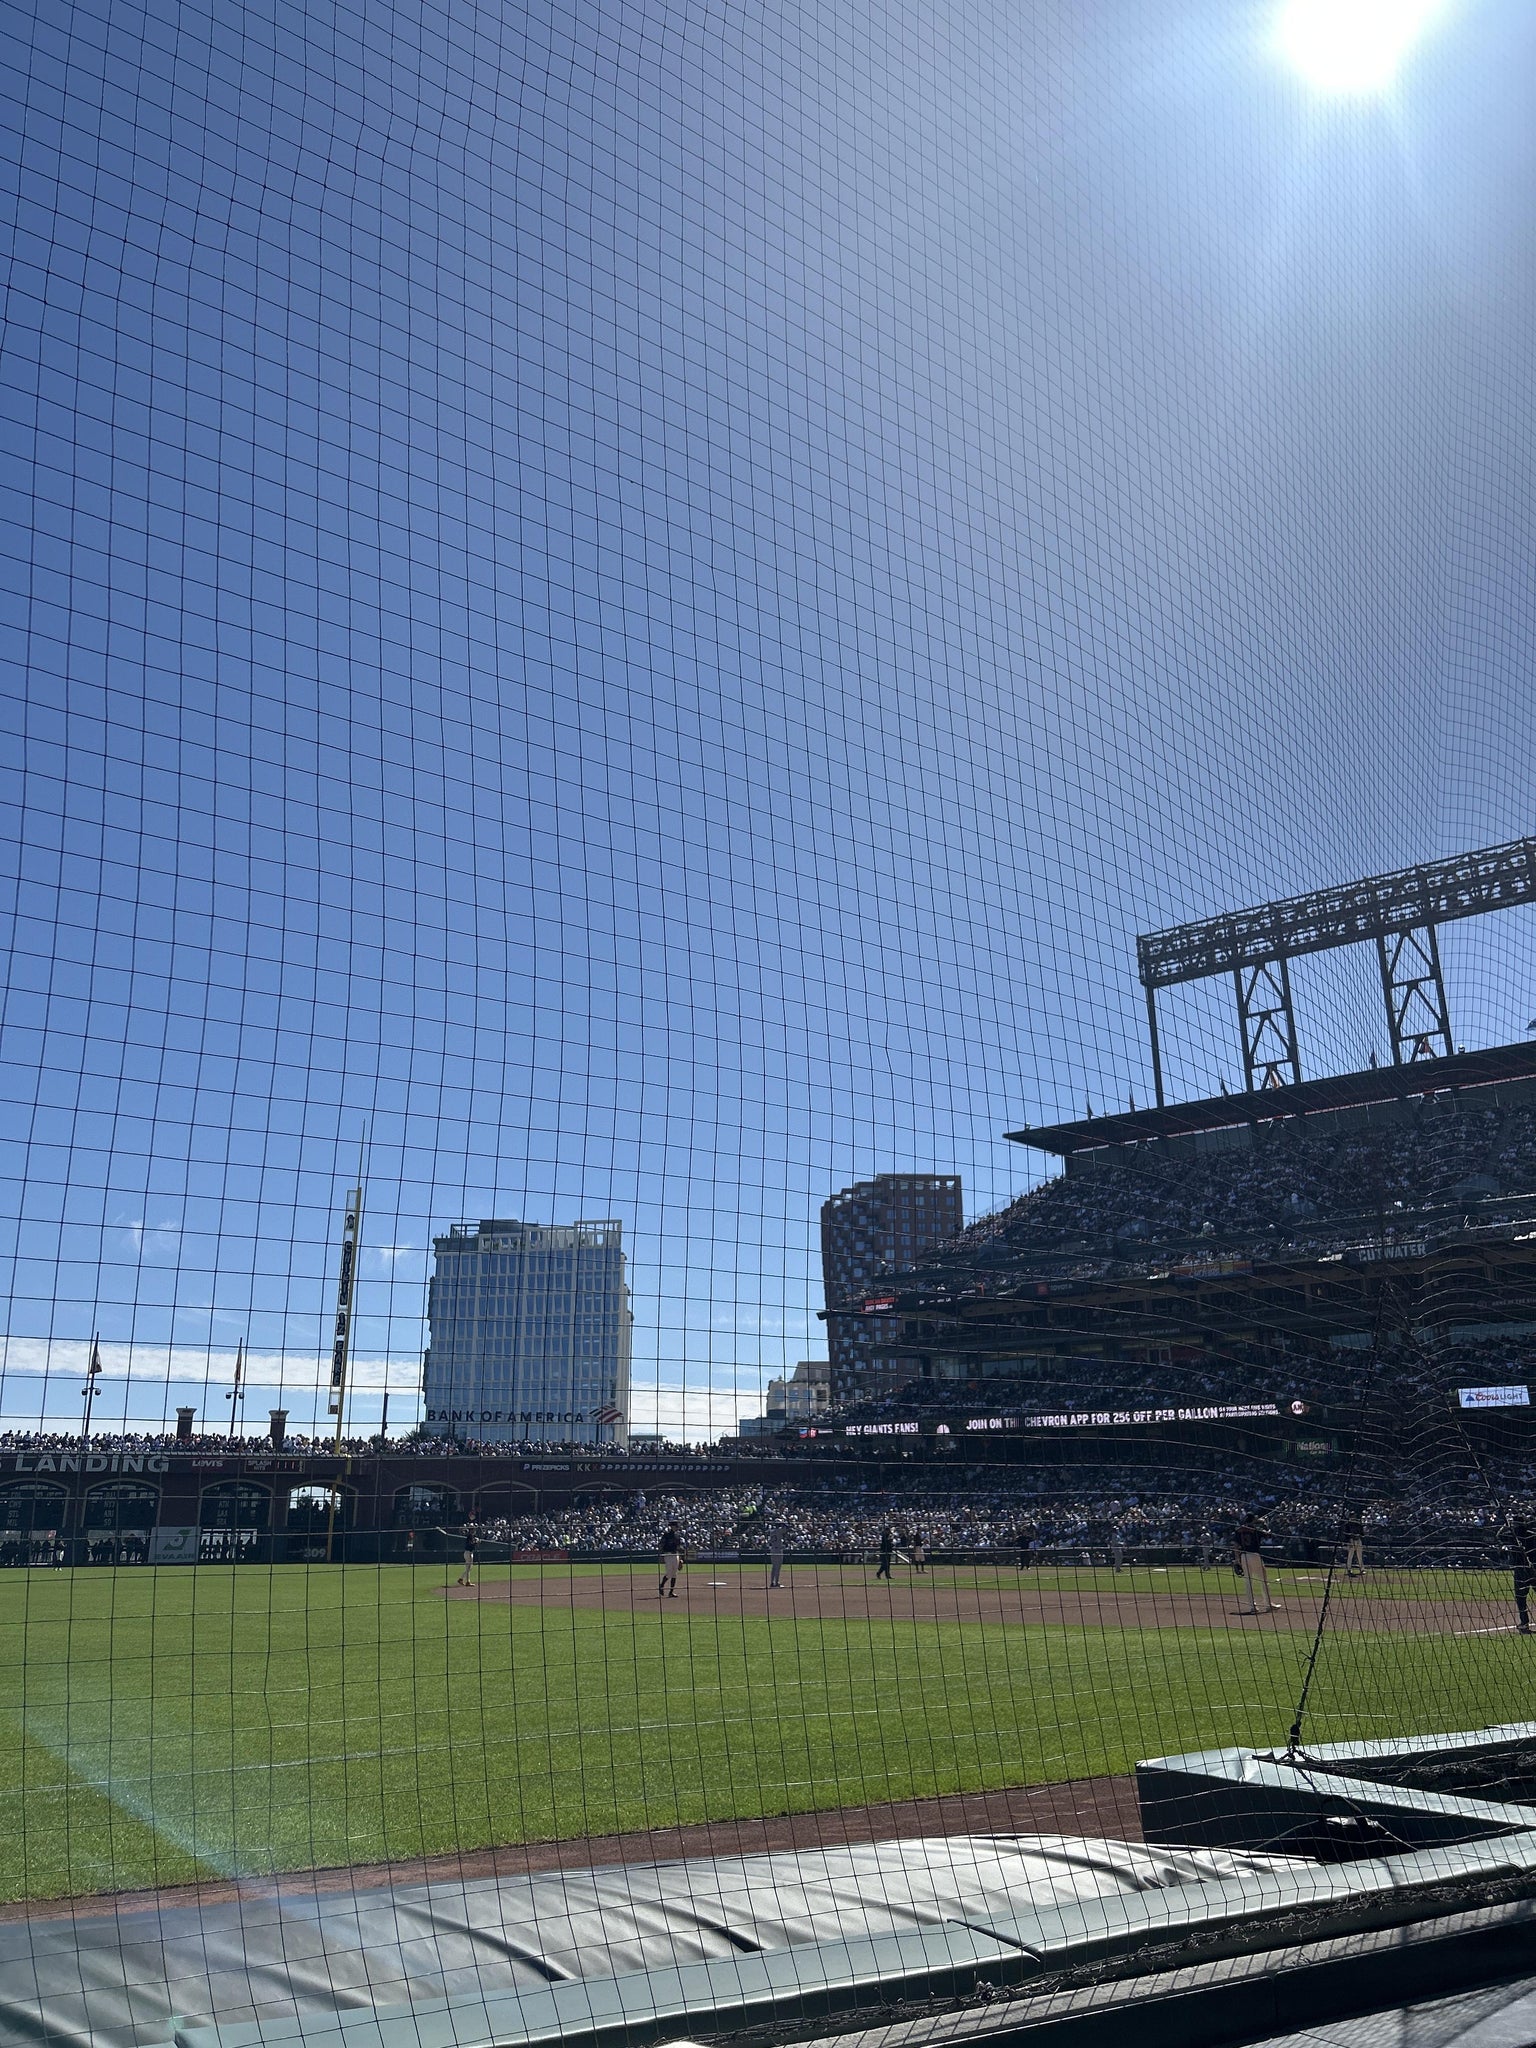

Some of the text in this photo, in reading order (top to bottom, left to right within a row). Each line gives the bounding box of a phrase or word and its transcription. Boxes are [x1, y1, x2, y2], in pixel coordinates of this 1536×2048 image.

[1358, 1243, 1426, 1262] CUTWATER
[1475, 1392, 1523, 1402] Coors LIGHT
[427, 1409, 584, 1423] BANK OF AMERICA
[966, 1418, 988, 1430] JOIN
[989, 1418, 1002, 1429] ON
[1024, 1415, 1067, 1427] CHEVRON
[1070, 1413, 1089, 1425] APP
[1091, 1412, 1110, 1424] FOR
[1133, 1410, 1152, 1422] OFF
[1155, 1409, 1175, 1421] PER
[1178, 1406, 1219, 1420] GALLON
[845, 1425, 862, 1435] HEY
[863, 1423, 893, 1435] GIANTS
[894, 1422, 919, 1434] FANS!
[15, 1454, 169, 1473] LANDING
[303, 1548, 326, 1558] 309
